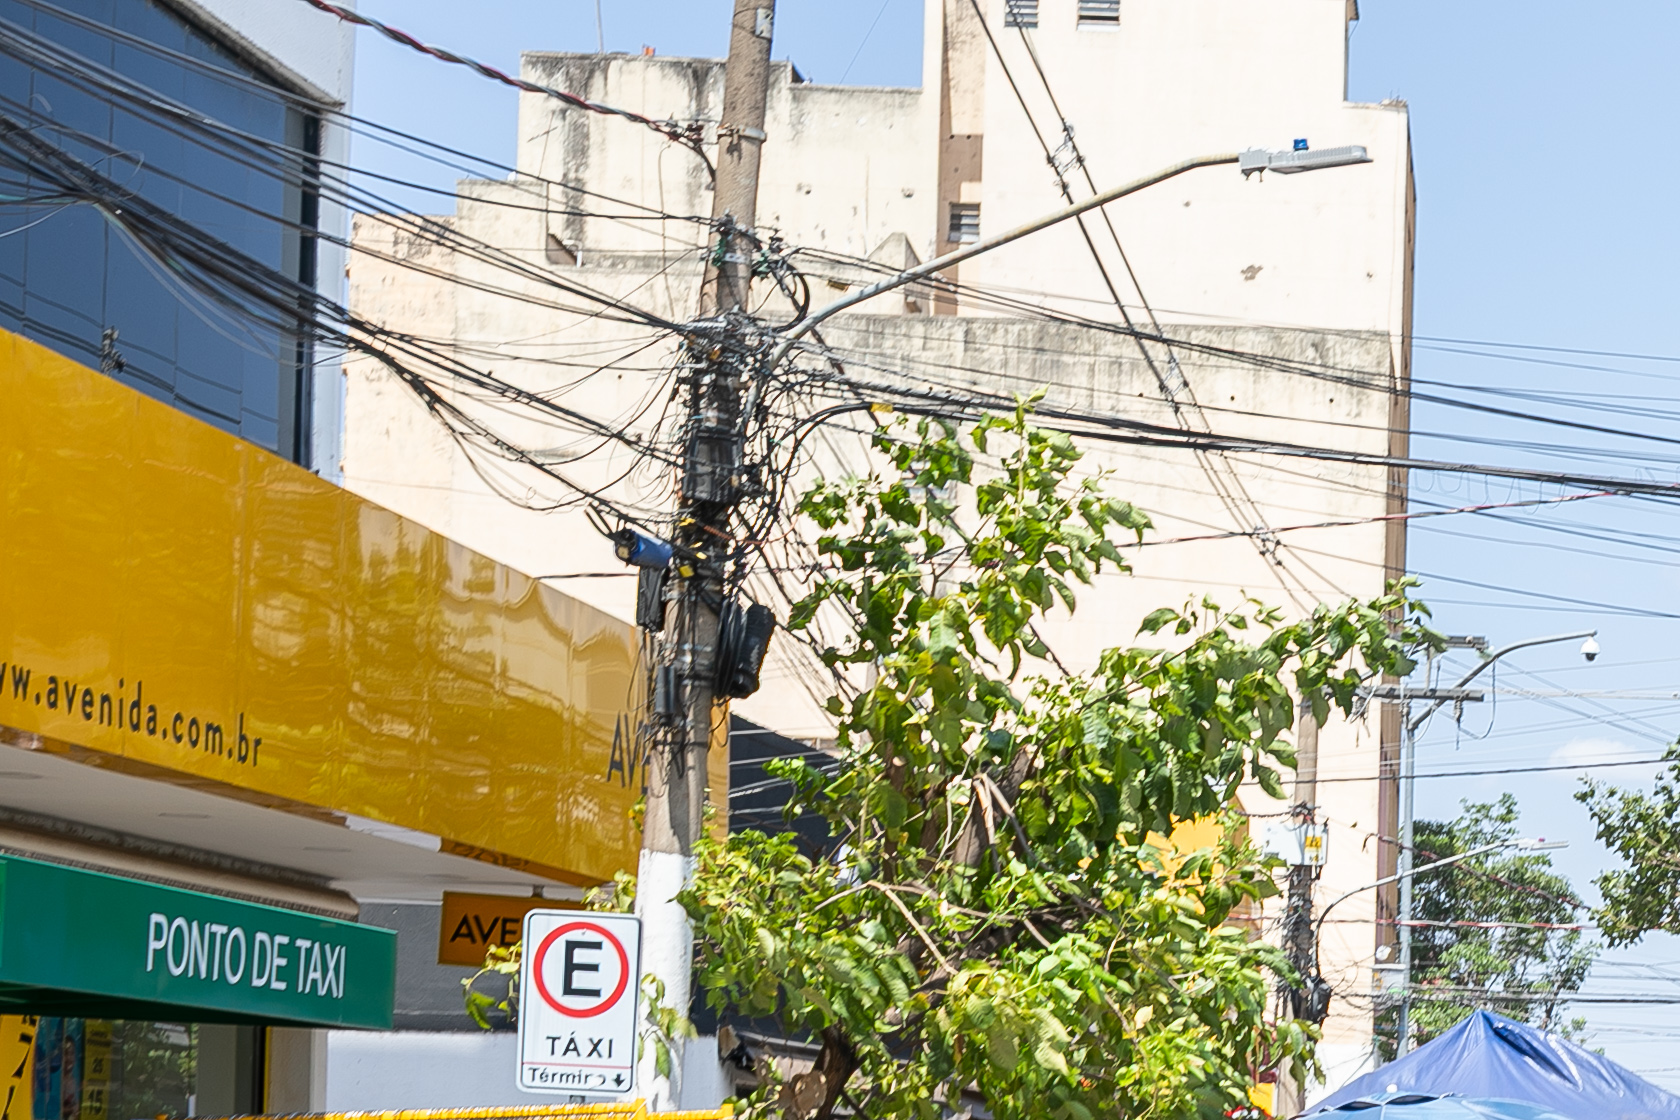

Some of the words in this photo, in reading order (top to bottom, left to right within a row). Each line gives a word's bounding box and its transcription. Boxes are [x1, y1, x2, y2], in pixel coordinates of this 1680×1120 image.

[146, 911, 245, 986] PONTO
[252, 931, 288, 990] DE
[296, 936, 346, 998] TAXI
[562, 939, 604, 998] E
[546, 1031, 614, 1059] TÁXI
